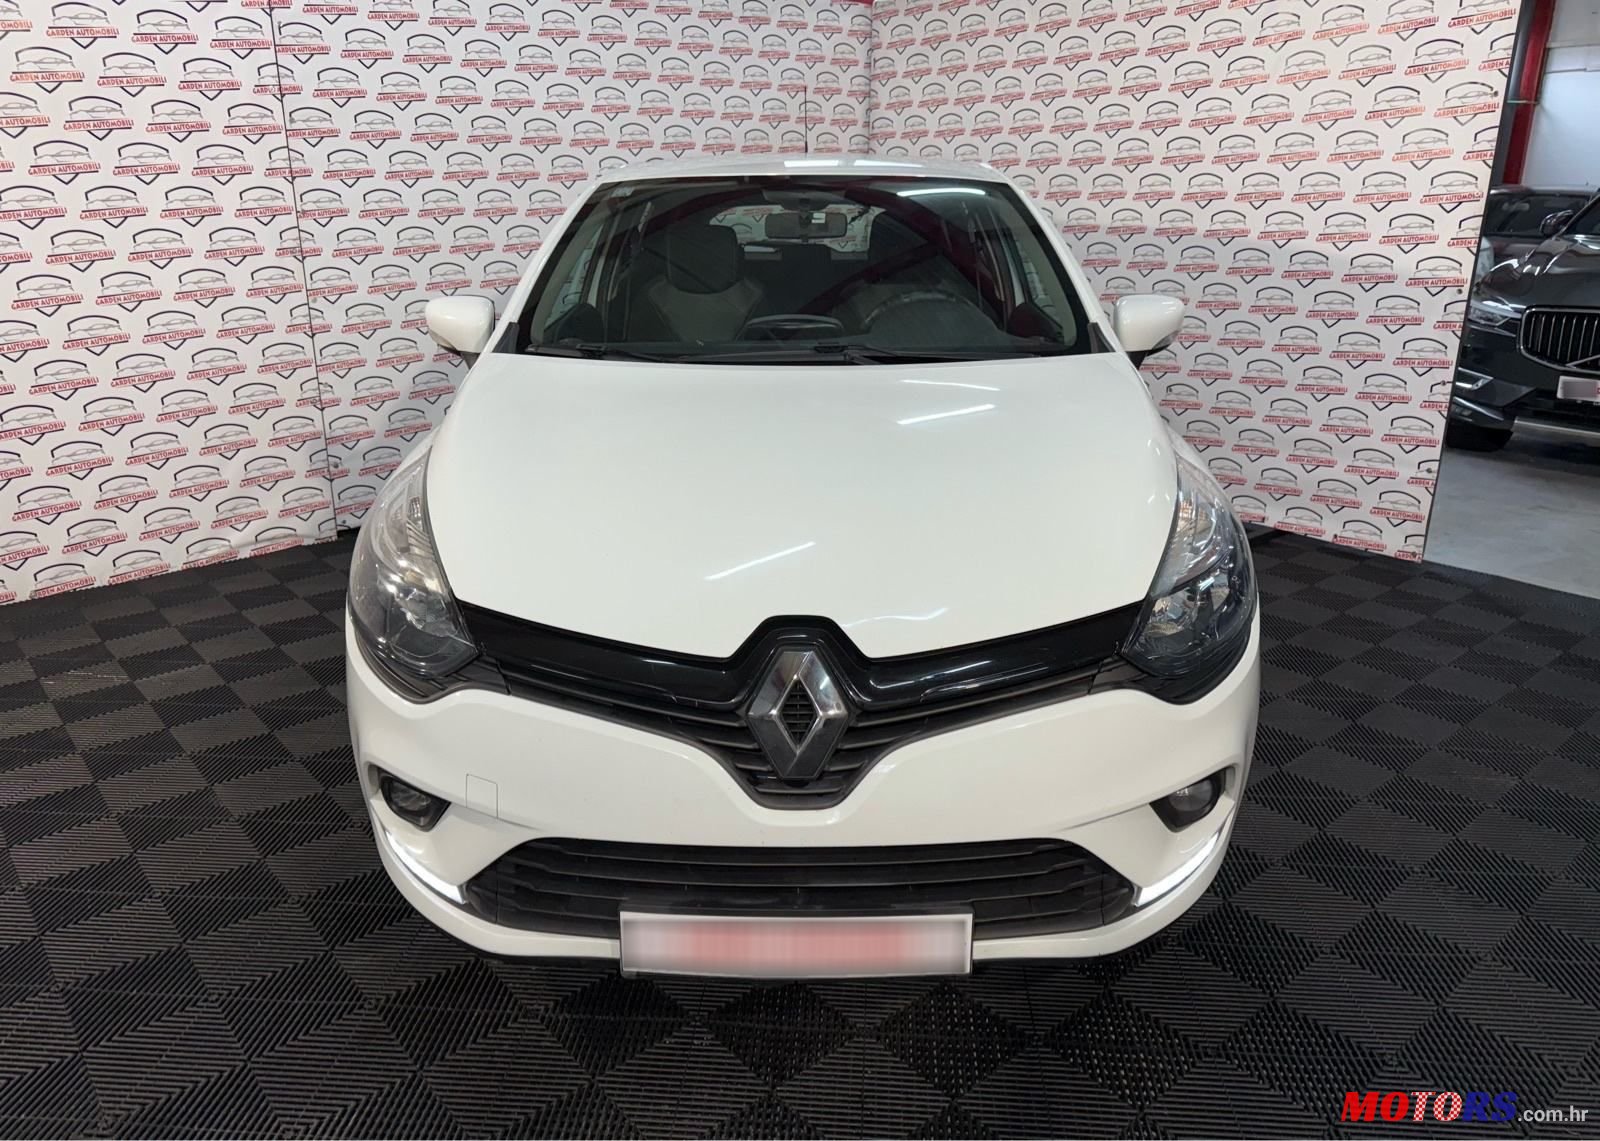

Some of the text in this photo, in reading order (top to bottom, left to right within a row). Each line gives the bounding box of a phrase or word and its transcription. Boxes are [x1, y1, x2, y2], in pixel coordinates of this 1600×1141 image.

[1476, 9, 1515, 23] AUTOMOBILI
[1402, 17, 1439, 30] AUTOMOBILI
[918, 33, 959, 45] AUTOMOBILI
[1430, 60, 1468, 71] AUTOMOBILI
[1389, 106, 1425, 117] AUTOMOBILI
[1460, 102, 1500, 114] AUTOMOBILI
[92, 120, 133, 128] AUTOMOBILI
[1416, 149, 1452, 159] AUTOMOBILI
[58, 163, 100, 173] AUTOMOBILI
[140, 164, 180, 173] AUTOMOBILI
[217, 166, 253, 174] AUTOMOBILI
[108, 208, 147, 217] AUTOMOBILI
[187, 207, 224, 216] AUTOMOBILI
[259, 206, 294, 215] AUTOMOBILI
[1403, 235, 1439, 243] AUTOMOBILI
[74, 251, 113, 261] AUTOMOBILI
[155, 248, 193, 259] AUTOMOBILI
[229, 247, 265, 256] AUTOMOBILI
[123, 291, 161, 302] AUTOMOBILI
[199, 287, 235, 298] AUTOMOBILI
[41, 295, 82, 306] AUTOMOBILI
[168, 329, 205, 340] AUTOMOBILI
[241, 324, 275, 335] AUTOMOBILI
[90, 334, 130, 346] AUTOMOBILI
[138, 370, 176, 383] AUTOMOBILI
[58, 378, 98, 390] AUTOMOBILI
[182, 405, 218, 418] AUTOMOBILI
[106, 413, 144, 426] AUTOMOBILI
[1404, 437, 1440, 446] AUTOMOBILI
[152, 448, 187, 461] AUTOMOBILI
[74, 457, 112, 471] AUTOMOBILI
[120, 490, 156, 504] AUTOMOBILI
[41, 501, 80, 516] AUTOMOBILI
[164, 521, 200, 535] AUTOMOBILI
[89, 533, 128, 548] AUTOMOBILI
